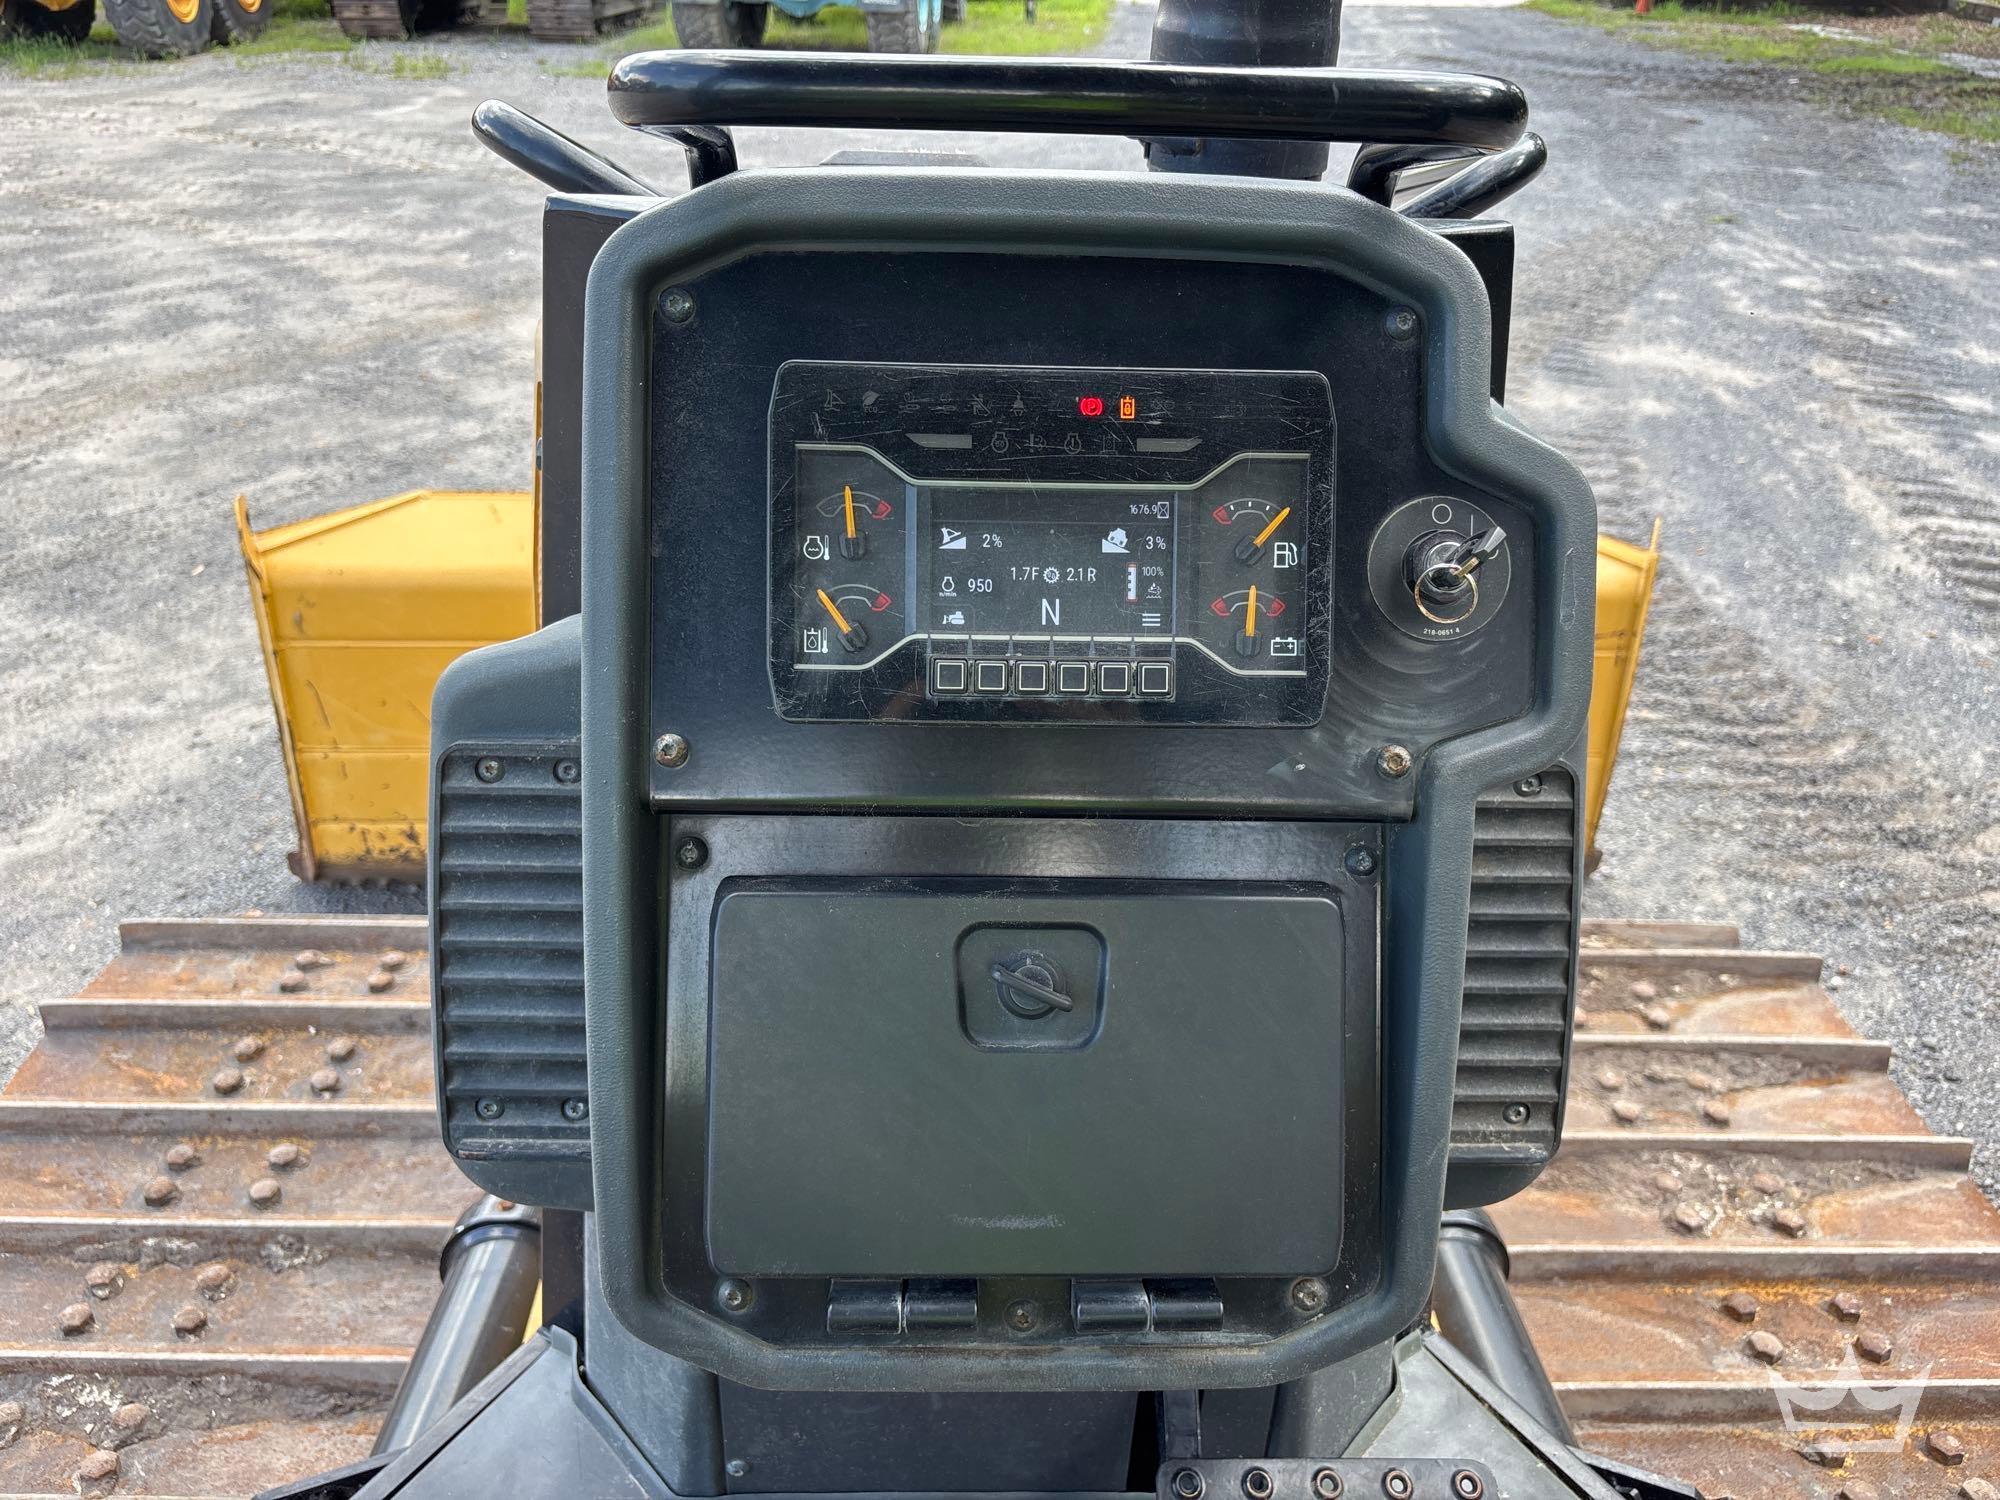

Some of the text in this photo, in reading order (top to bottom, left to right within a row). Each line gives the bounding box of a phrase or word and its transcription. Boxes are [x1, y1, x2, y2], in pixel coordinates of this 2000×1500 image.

[1129, 504, 1157, 515] 1676.9
[982, 534, 1003, 548] 2%
[1145, 536, 1166, 550] 3%
[1010, 566, 1040, 580] 1.7F
[1141, 566, 1164, 577] 100%
[967, 578, 993, 592] 950
[1041, 598, 1060, 625] N
